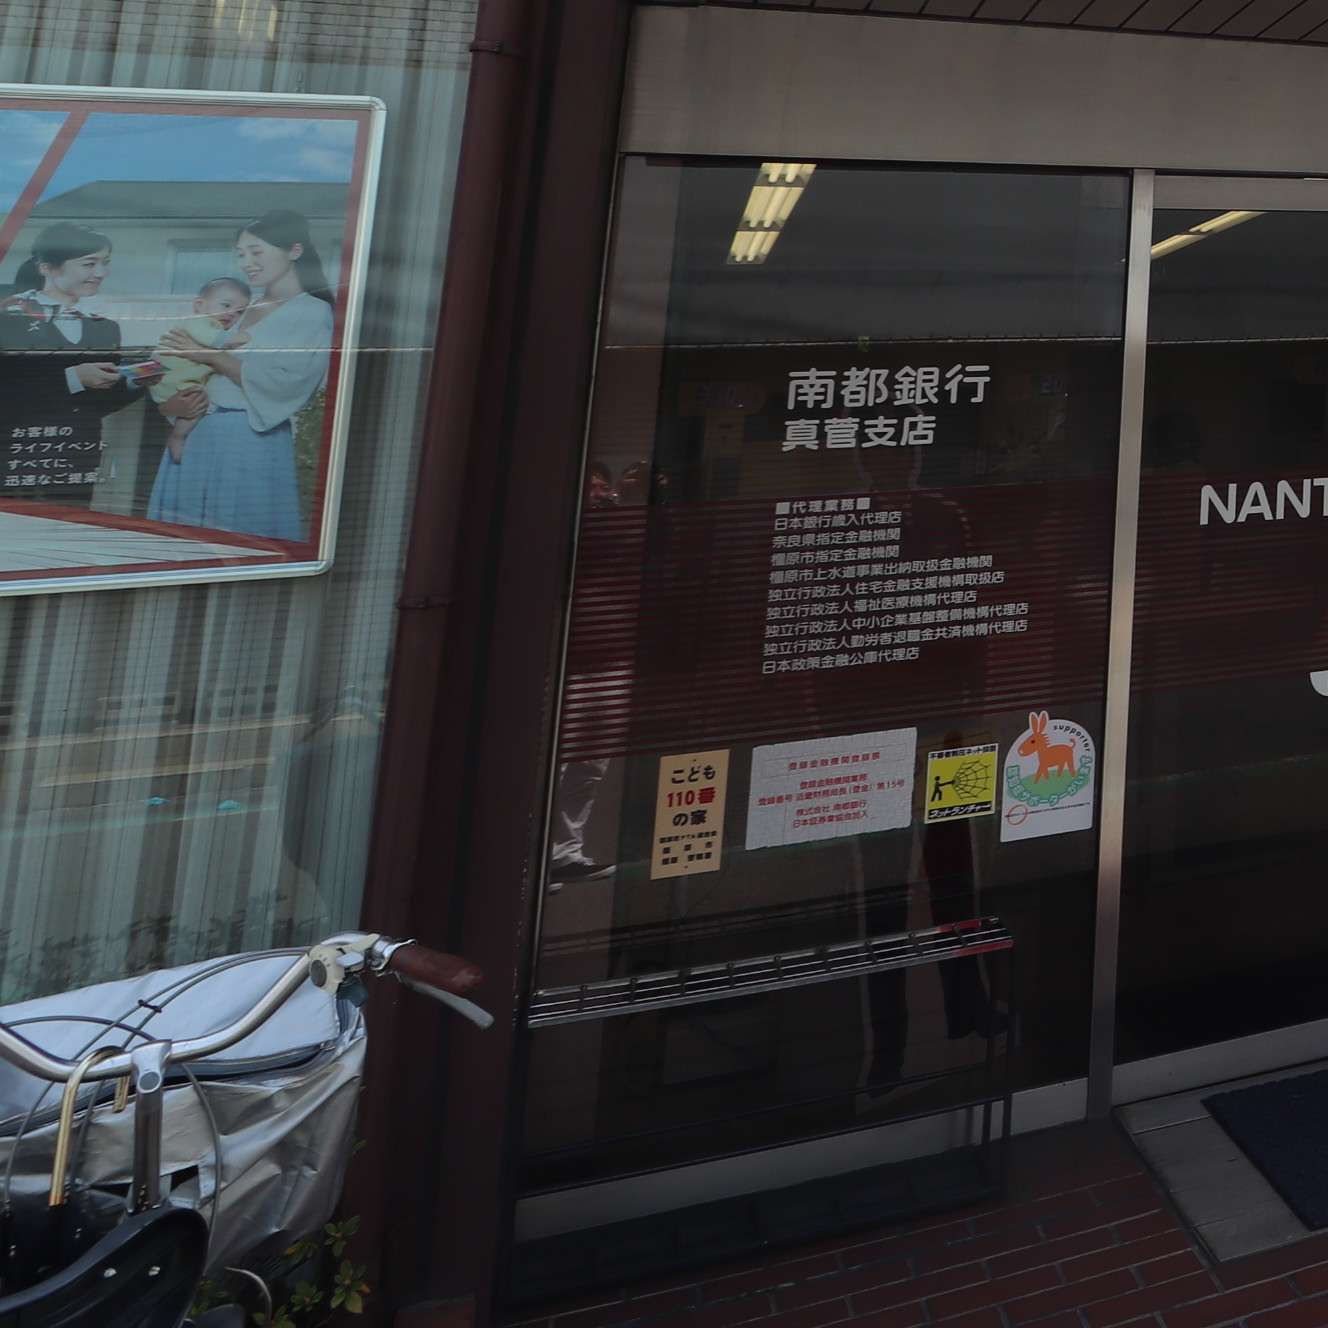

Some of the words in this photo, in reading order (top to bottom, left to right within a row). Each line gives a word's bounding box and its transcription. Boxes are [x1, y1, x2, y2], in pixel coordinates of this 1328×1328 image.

[787, 363, 991, 410] 南都銀行
[12, 426, 73, 438] お客様の
[781, 414, 936, 452] 真菅支店
[10, 440, 108, 454] ライフイベント
[8, 458, 74, 470] すべてに、
[4, 472, 106, 487] 迅速なご提案。
[774, 511, 902, 531] 日本銀行歳入代理店
[772, 528, 901, 548] 奈良県指定金融機関
[762, 647, 919, 674] 日本政策金融公庫代理店
[1053, 723, 1091, 753] supporter
[672, 765, 715, 784] こども
[667, 786, 716, 808] 110番
[672, 809, 707, 826] の家
[928, 801, 992, 819] ネットランチャー
